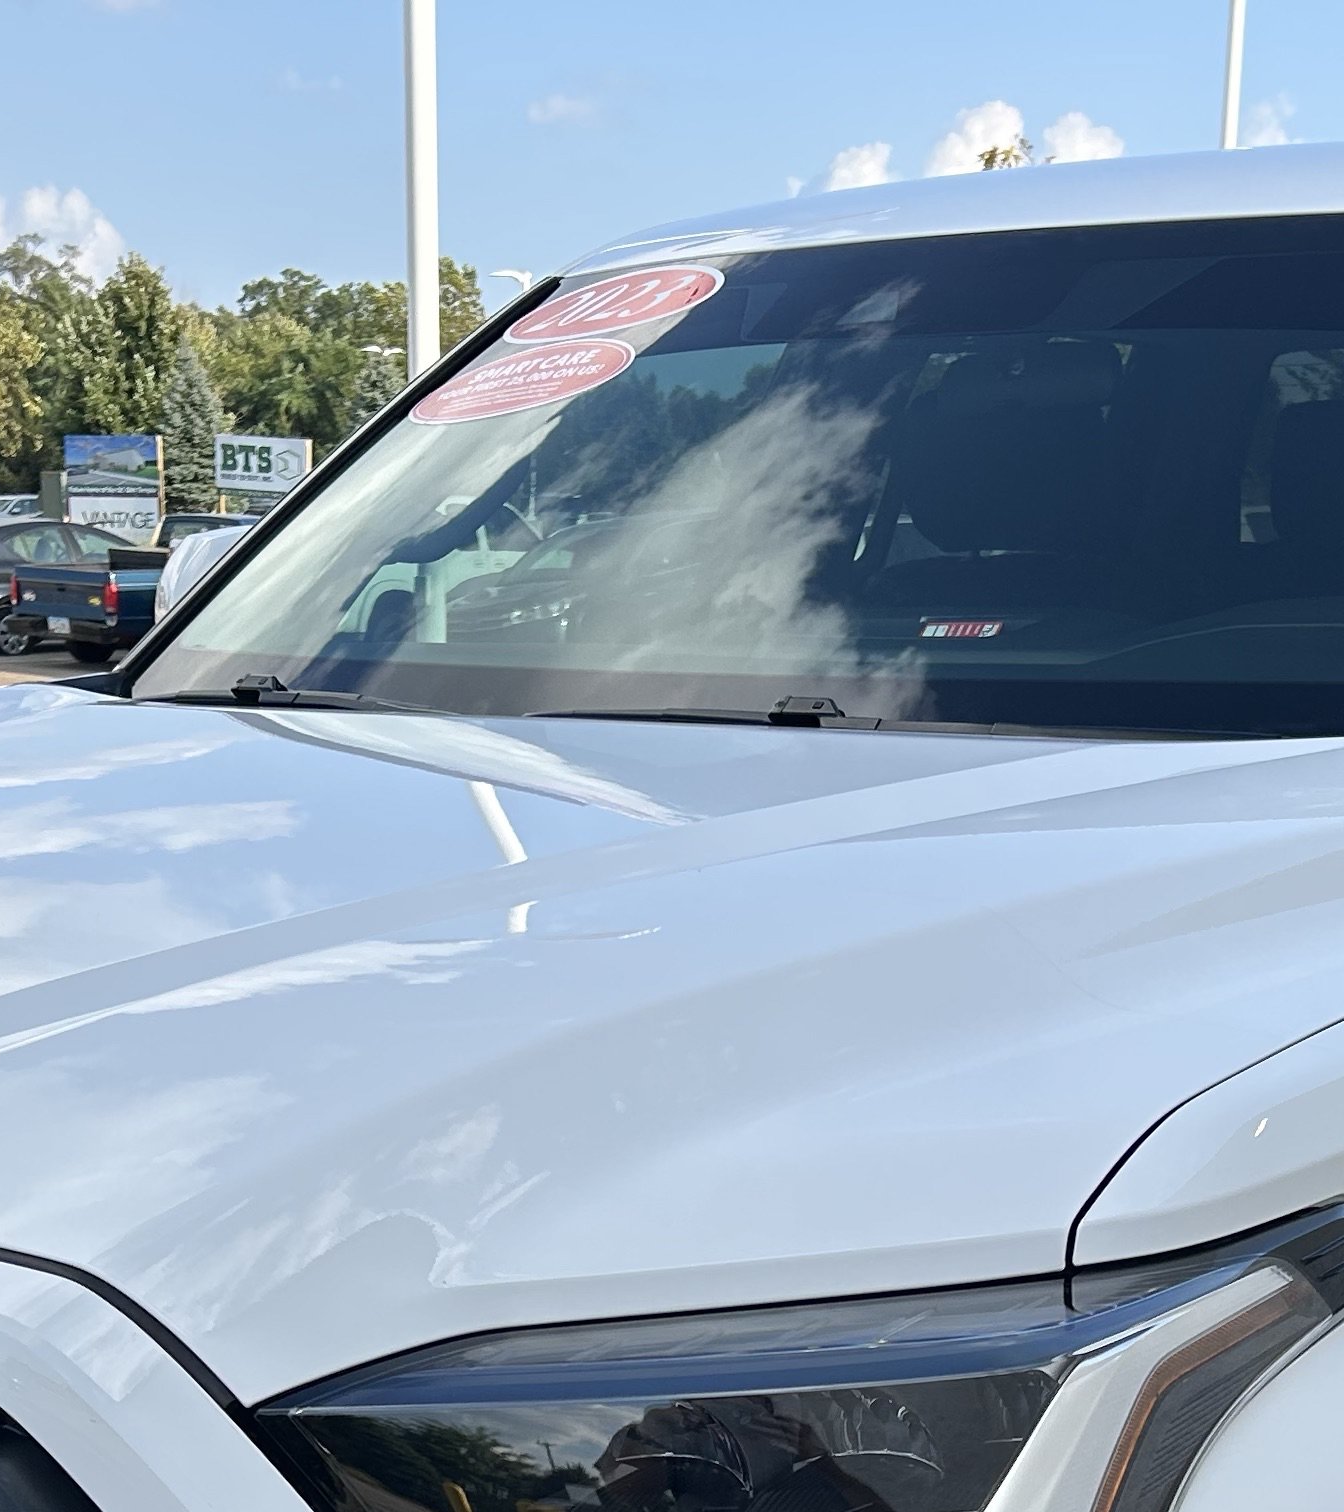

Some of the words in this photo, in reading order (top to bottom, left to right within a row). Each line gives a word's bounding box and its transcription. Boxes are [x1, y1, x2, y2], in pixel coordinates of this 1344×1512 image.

[522, 274, 698, 334] 2023
[468, 358, 542, 385] SMART
[540, 348, 602, 369] CARE
[221, 443, 272, 474] BTS
